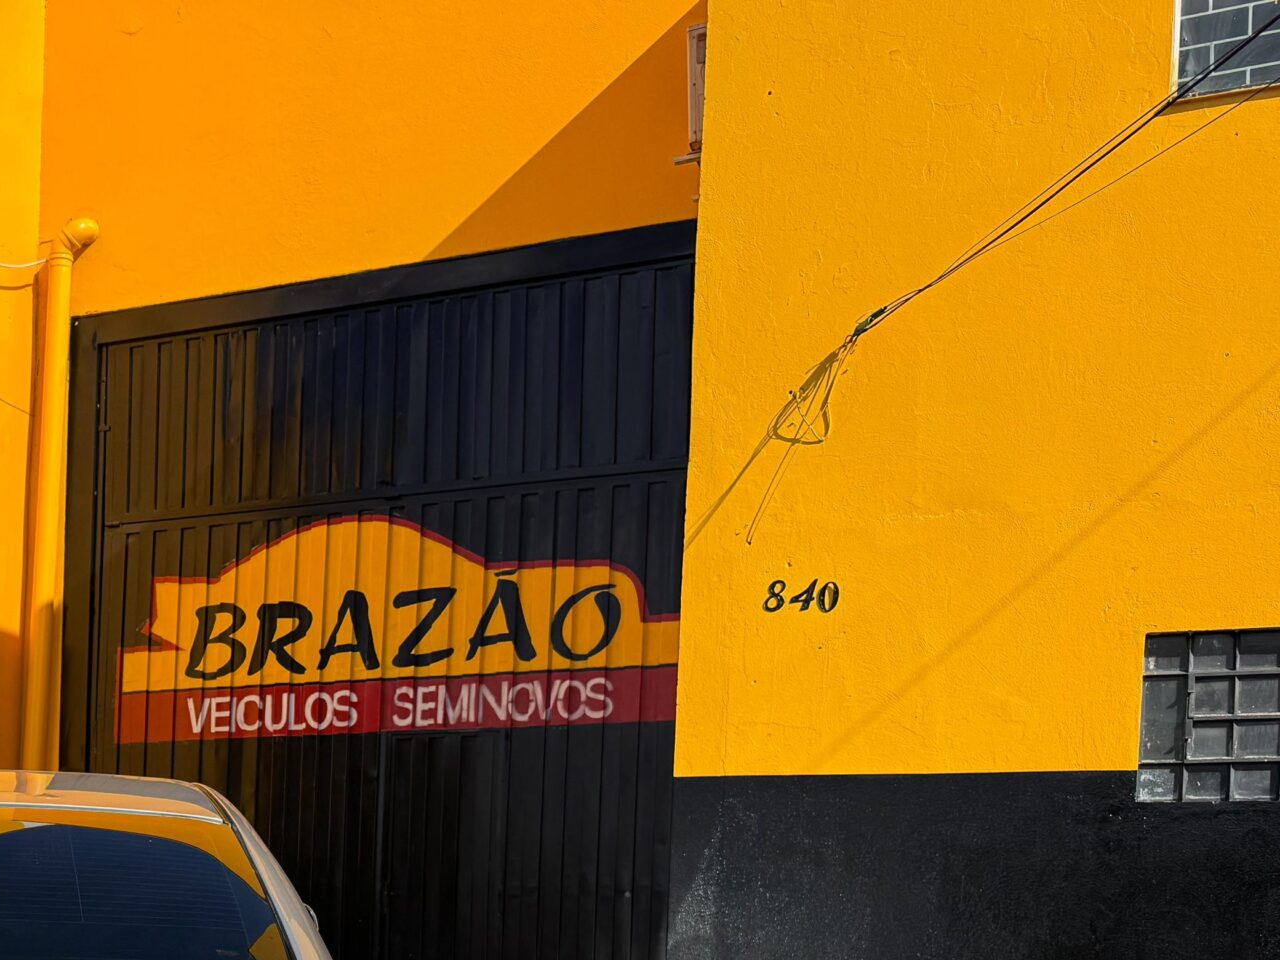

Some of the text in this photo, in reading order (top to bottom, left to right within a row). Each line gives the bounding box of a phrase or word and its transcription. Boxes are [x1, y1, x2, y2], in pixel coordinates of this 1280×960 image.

[762, 578, 840, 613] 840
[185, 569, 622, 680] BRAZÃO
[187, 677, 614, 733] VEICULOS SEMINOVOS
